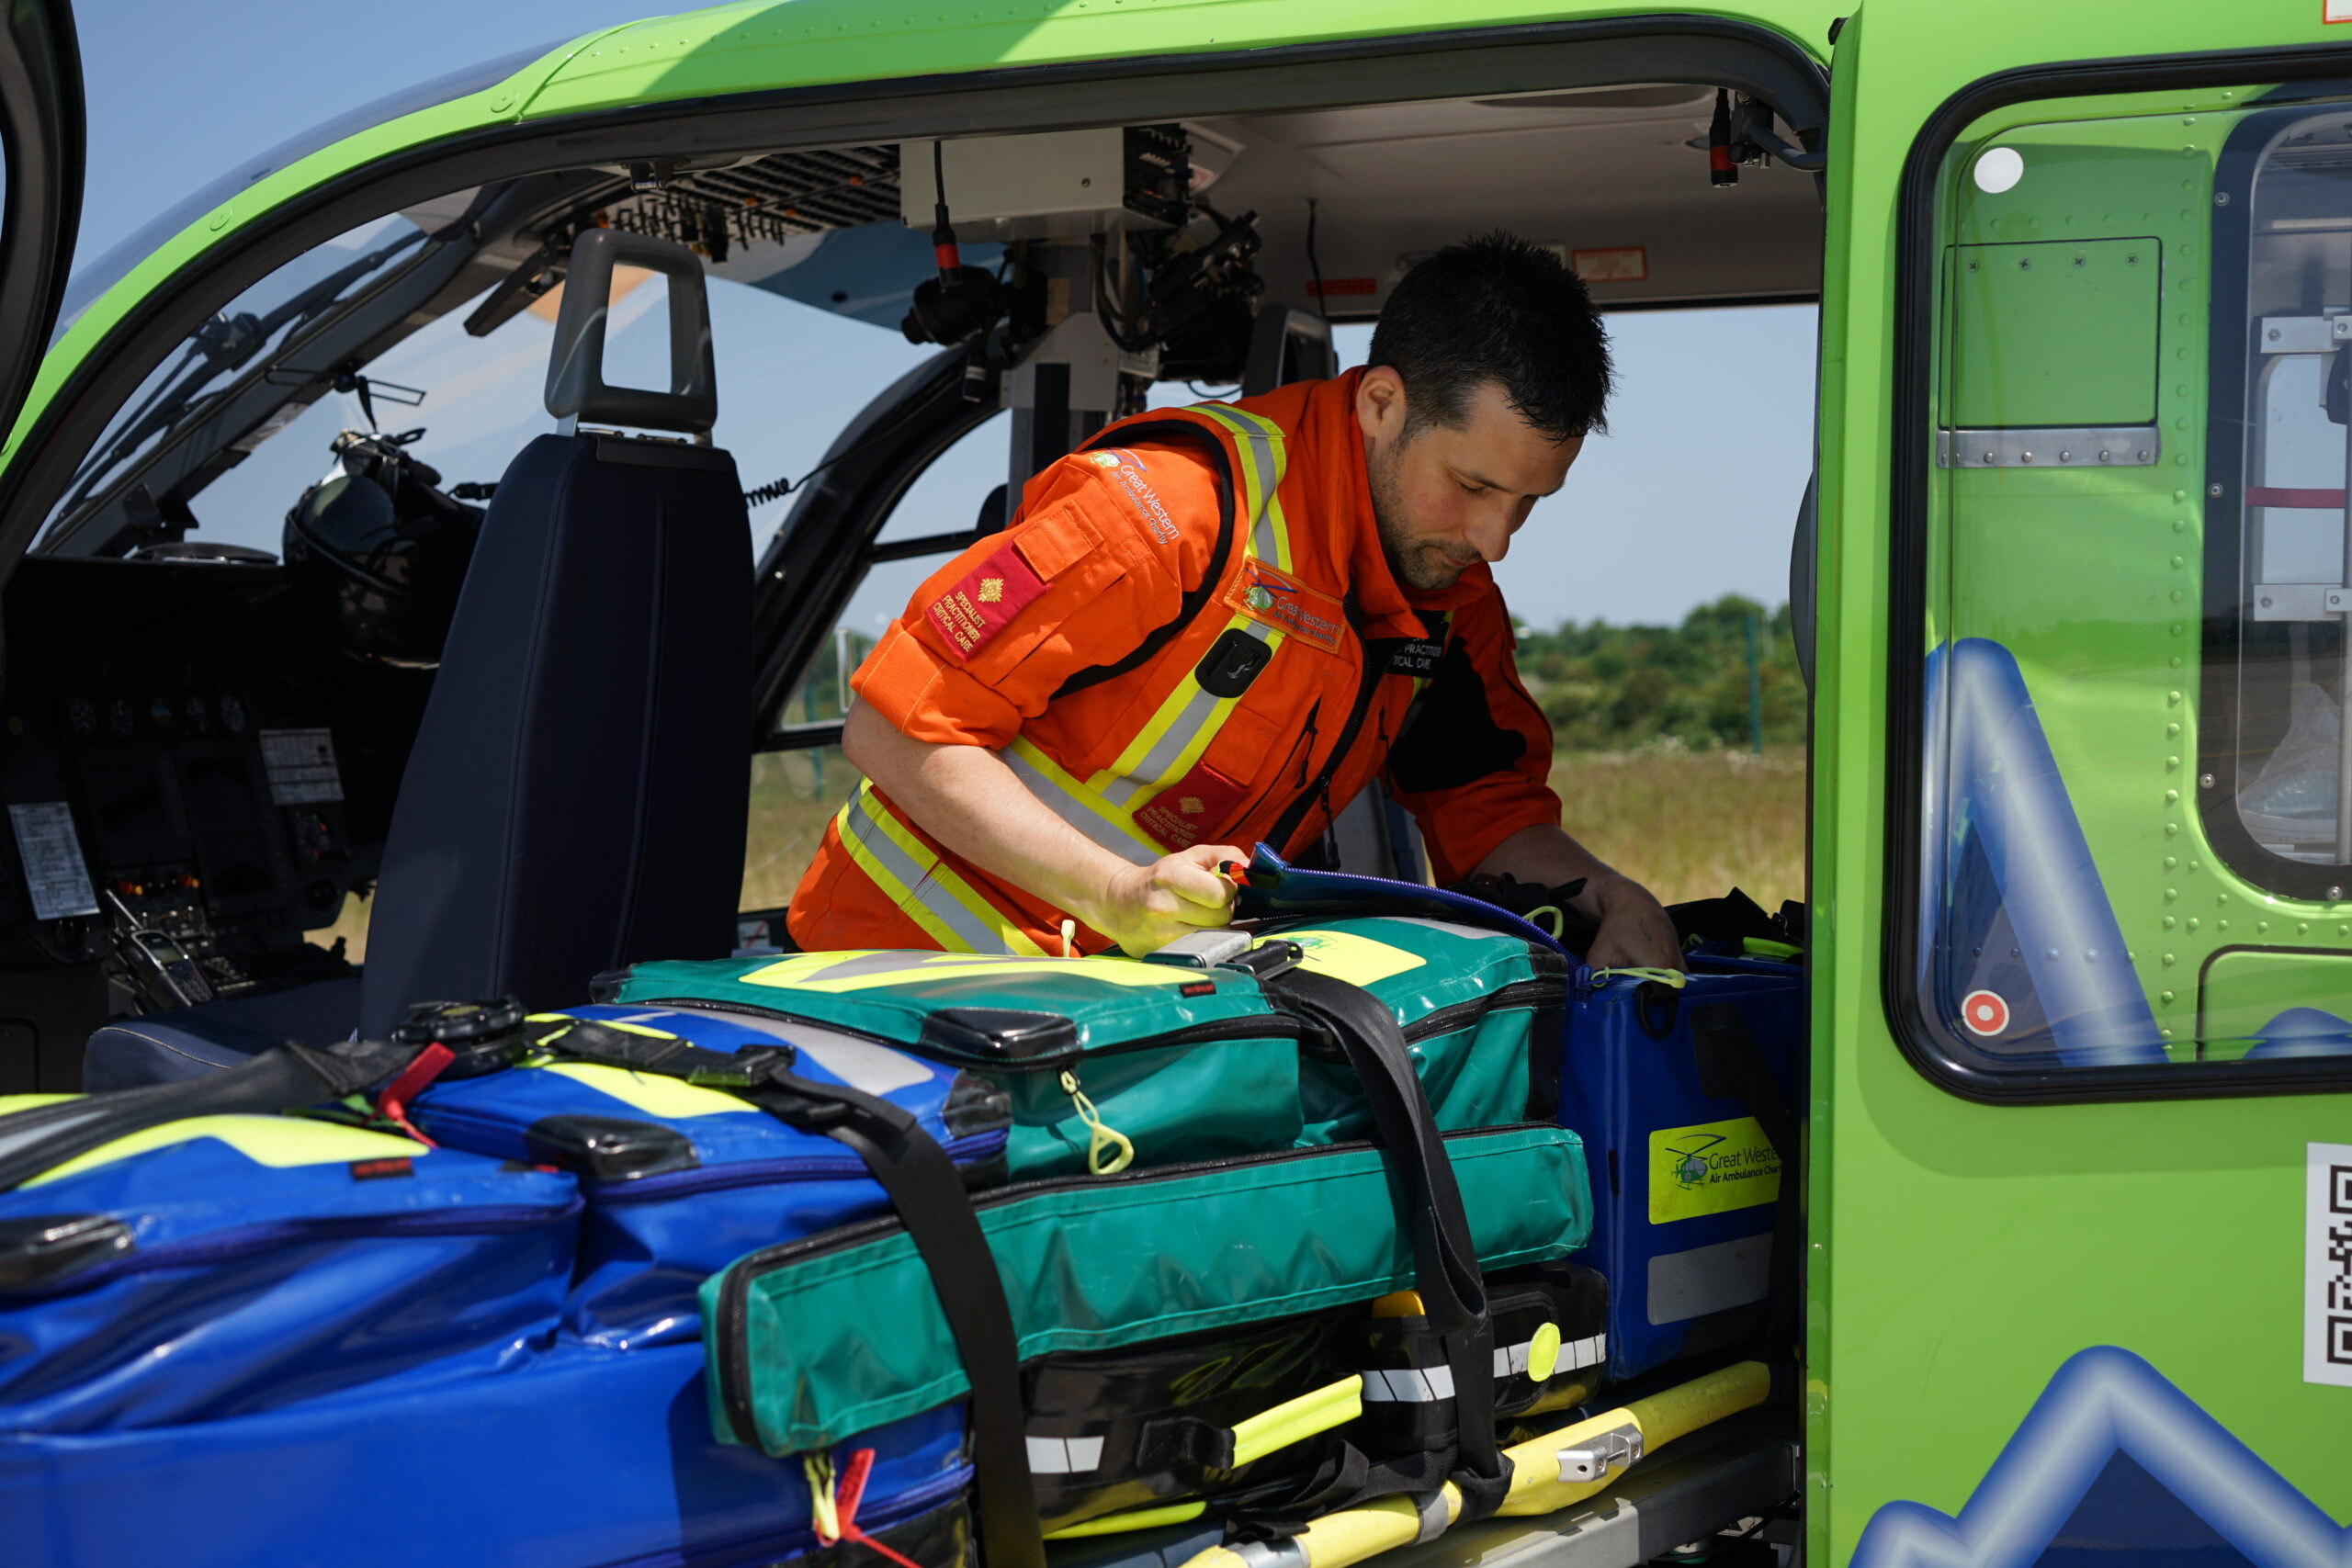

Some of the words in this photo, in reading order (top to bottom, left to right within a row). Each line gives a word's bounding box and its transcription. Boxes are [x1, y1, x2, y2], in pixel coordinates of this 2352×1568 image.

[1112, 471, 1122, 479] Air
[1121, 481, 1149, 518] Ambulance
[1148, 518, 1167, 544] Charity
[1120, 465, 1147, 492] Great
[1143, 489, 1179, 539] Western
[933, 602, 956, 633] CRITICAL
[955, 631, 974, 652] CARE
[942, 594, 981, 642] PRACTITIONER
[955, 591, 986, 628] SPECIALIST
[1309, 628, 1336, 645] Charity
[1139, 811, 1169, 838] CRITICAL
[1170, 833, 1193, 848] CARE
[1147, 807, 1195, 839] PRACTITIONER
[1159, 807, 1198, 830] SPECIALIST
[1709, 1152, 1740, 1169] Great
[1743, 1145, 1778, 1164] Weste
[1709, 1173, 1721, 1183] Air
[1723, 1168, 1762, 1182] Ambulance
